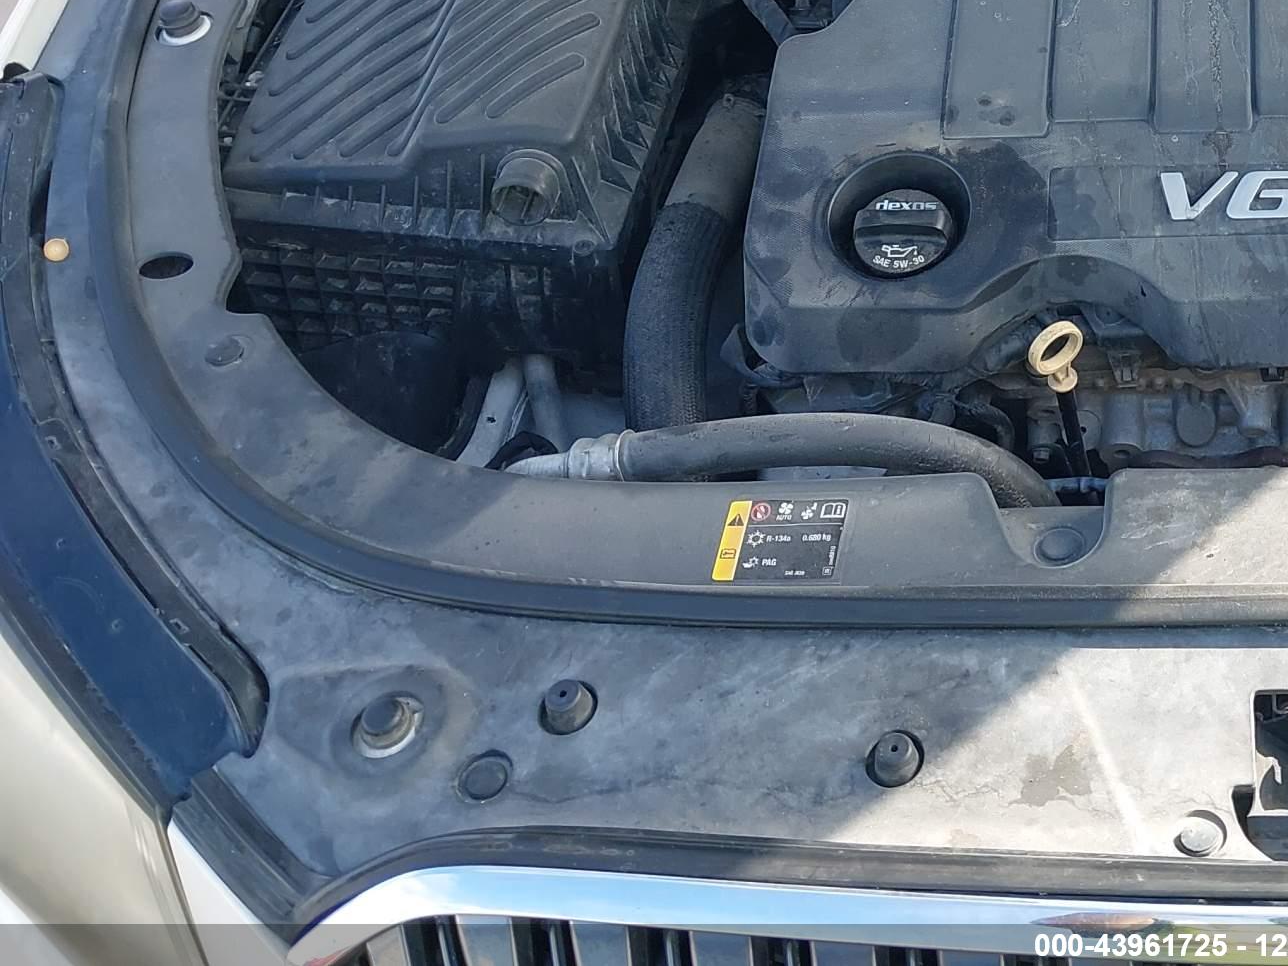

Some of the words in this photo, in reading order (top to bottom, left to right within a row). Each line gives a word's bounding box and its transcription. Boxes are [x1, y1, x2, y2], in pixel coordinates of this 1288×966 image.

[875, 199, 939, 211] dexos
[872, 255, 891, 268] SAE
[893, 254, 925, 269] 5W-30
[766, 534, 791, 542] R-134a
[761, 558, 777, 566] PAG
